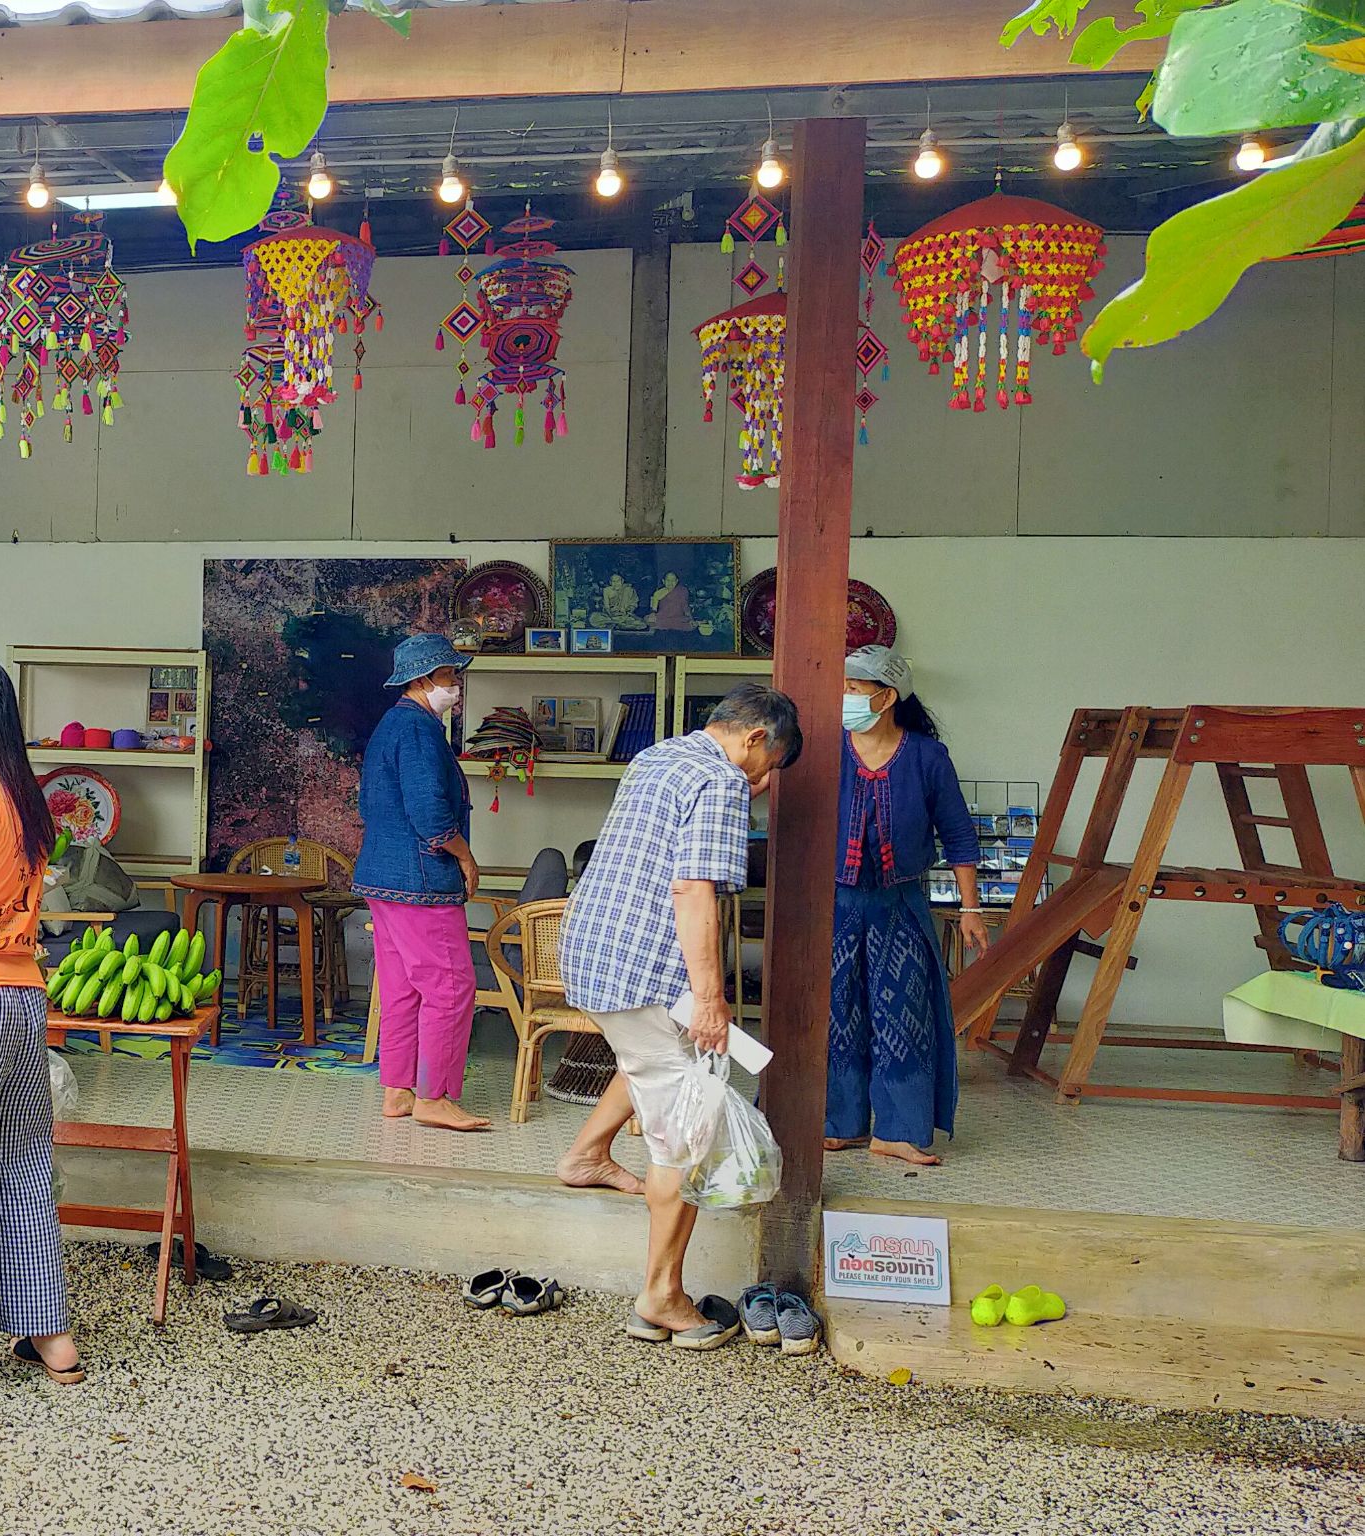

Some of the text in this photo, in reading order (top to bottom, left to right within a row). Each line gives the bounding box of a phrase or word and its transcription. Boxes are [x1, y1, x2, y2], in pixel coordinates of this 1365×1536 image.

[869, 1235, 935, 1259] กรุณา
[839, 1257, 934, 1276] ถอดรองเท้า
[838, 1271, 935, 1286] PLEASE TAKE OFF YOUR SHOES
